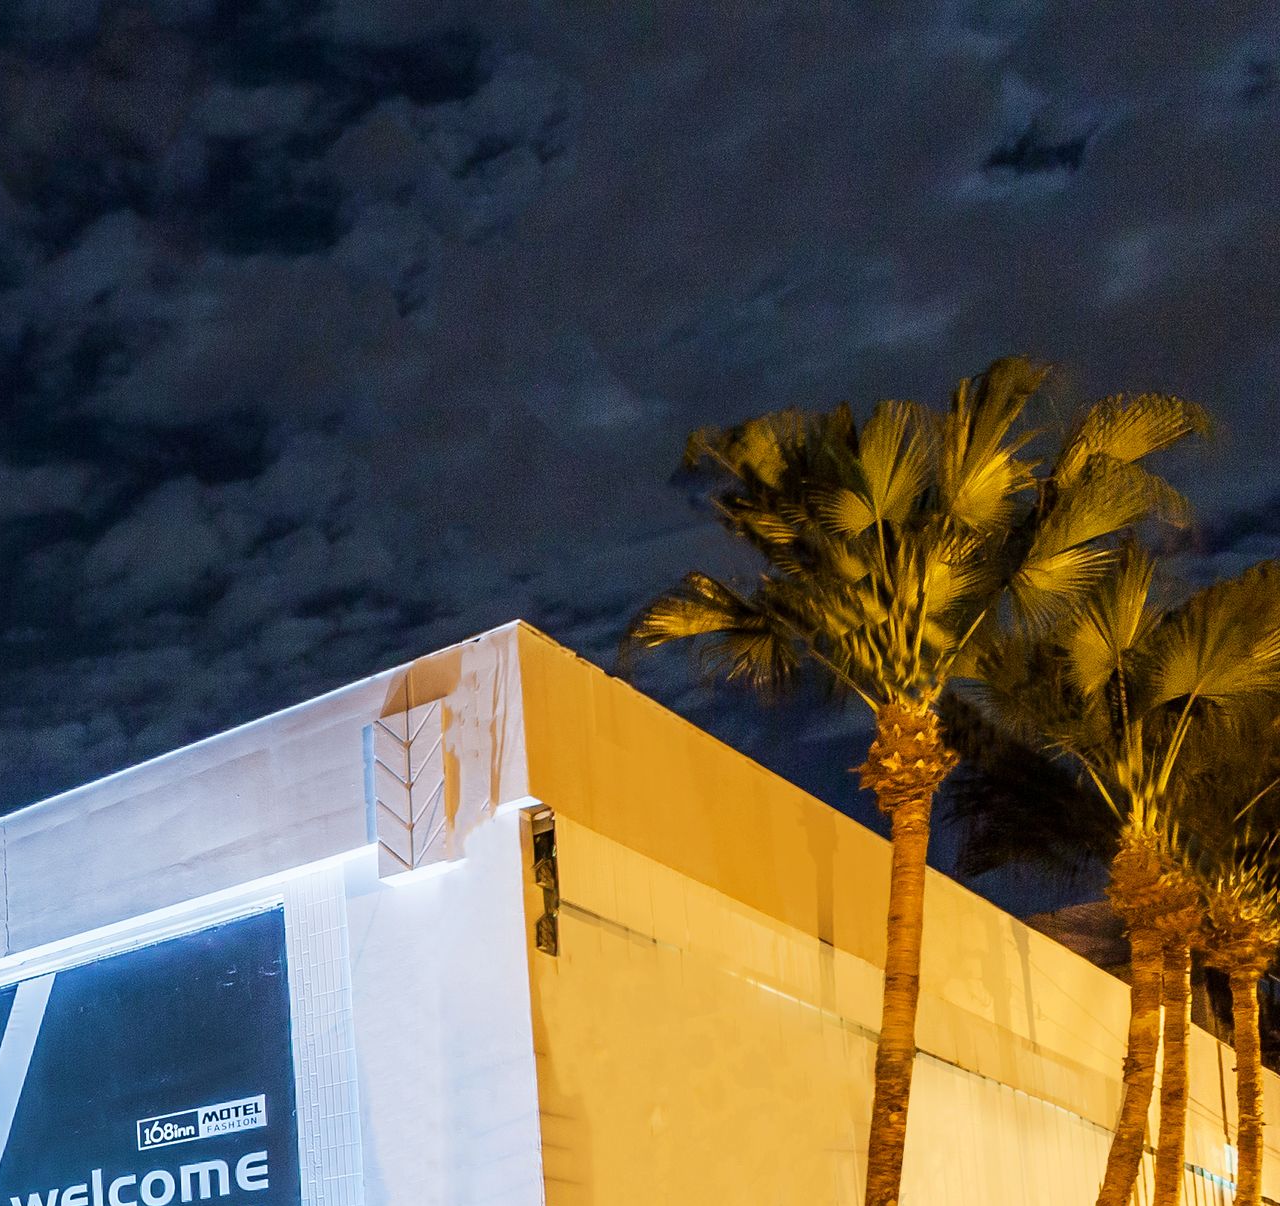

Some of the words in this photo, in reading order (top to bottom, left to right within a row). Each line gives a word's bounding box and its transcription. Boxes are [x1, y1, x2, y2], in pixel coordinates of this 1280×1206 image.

[202, 1102, 262, 1125] MOTEL
[144, 1121, 195, 1146] 168inn
[206, 1117, 258, 1134] FASHION
